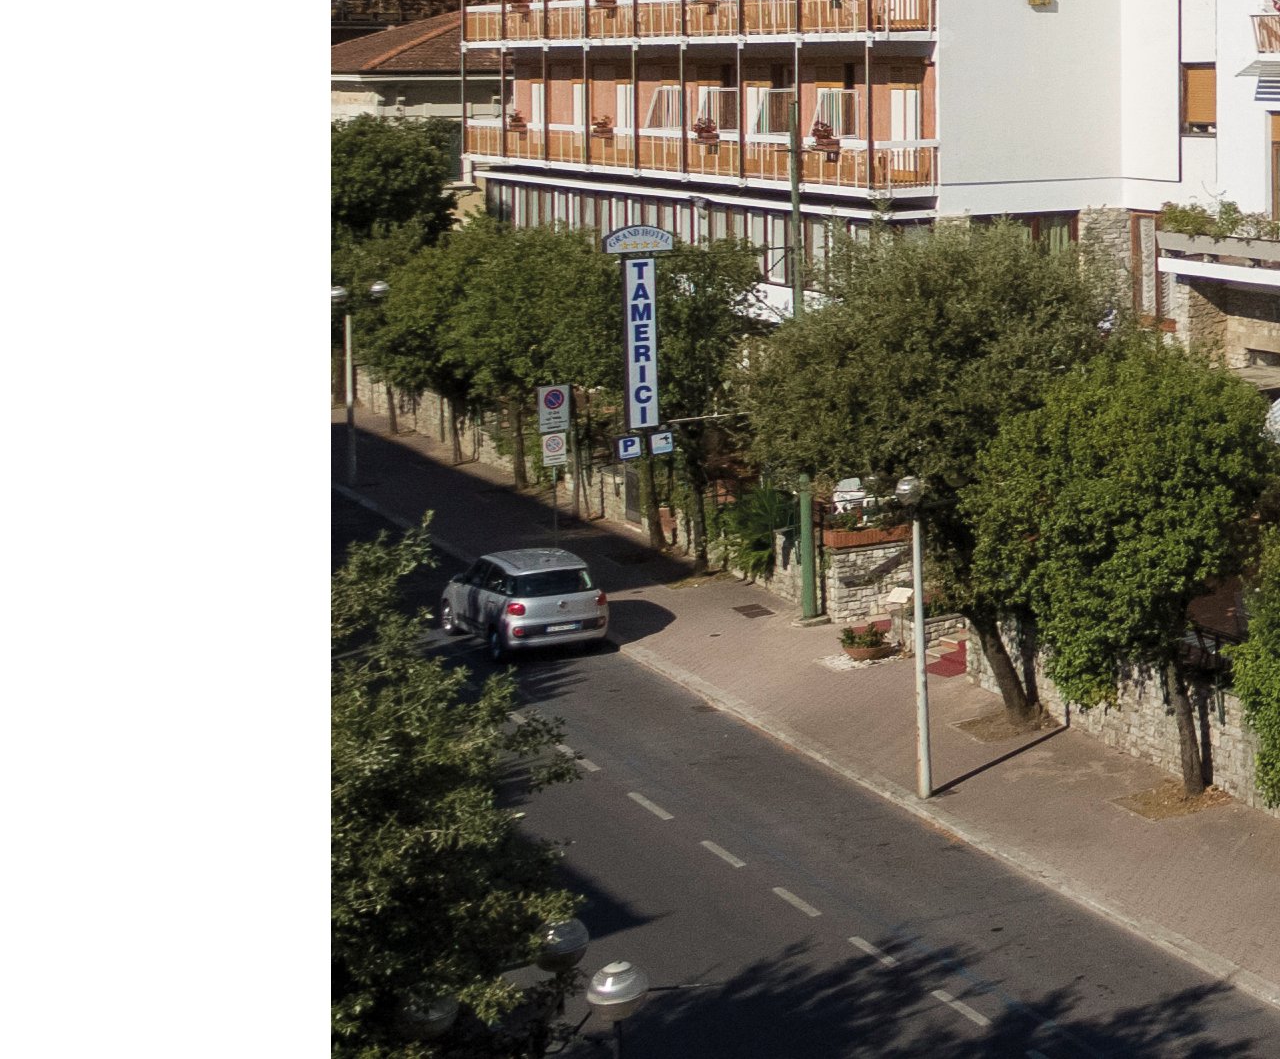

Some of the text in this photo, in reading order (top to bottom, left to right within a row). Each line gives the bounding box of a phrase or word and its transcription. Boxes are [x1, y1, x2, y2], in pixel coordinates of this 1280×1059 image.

[608, 229, 640, 248] GRAND
[631, 262, 653, 425] TAMERICI
[623, 439, 636, 453] P
